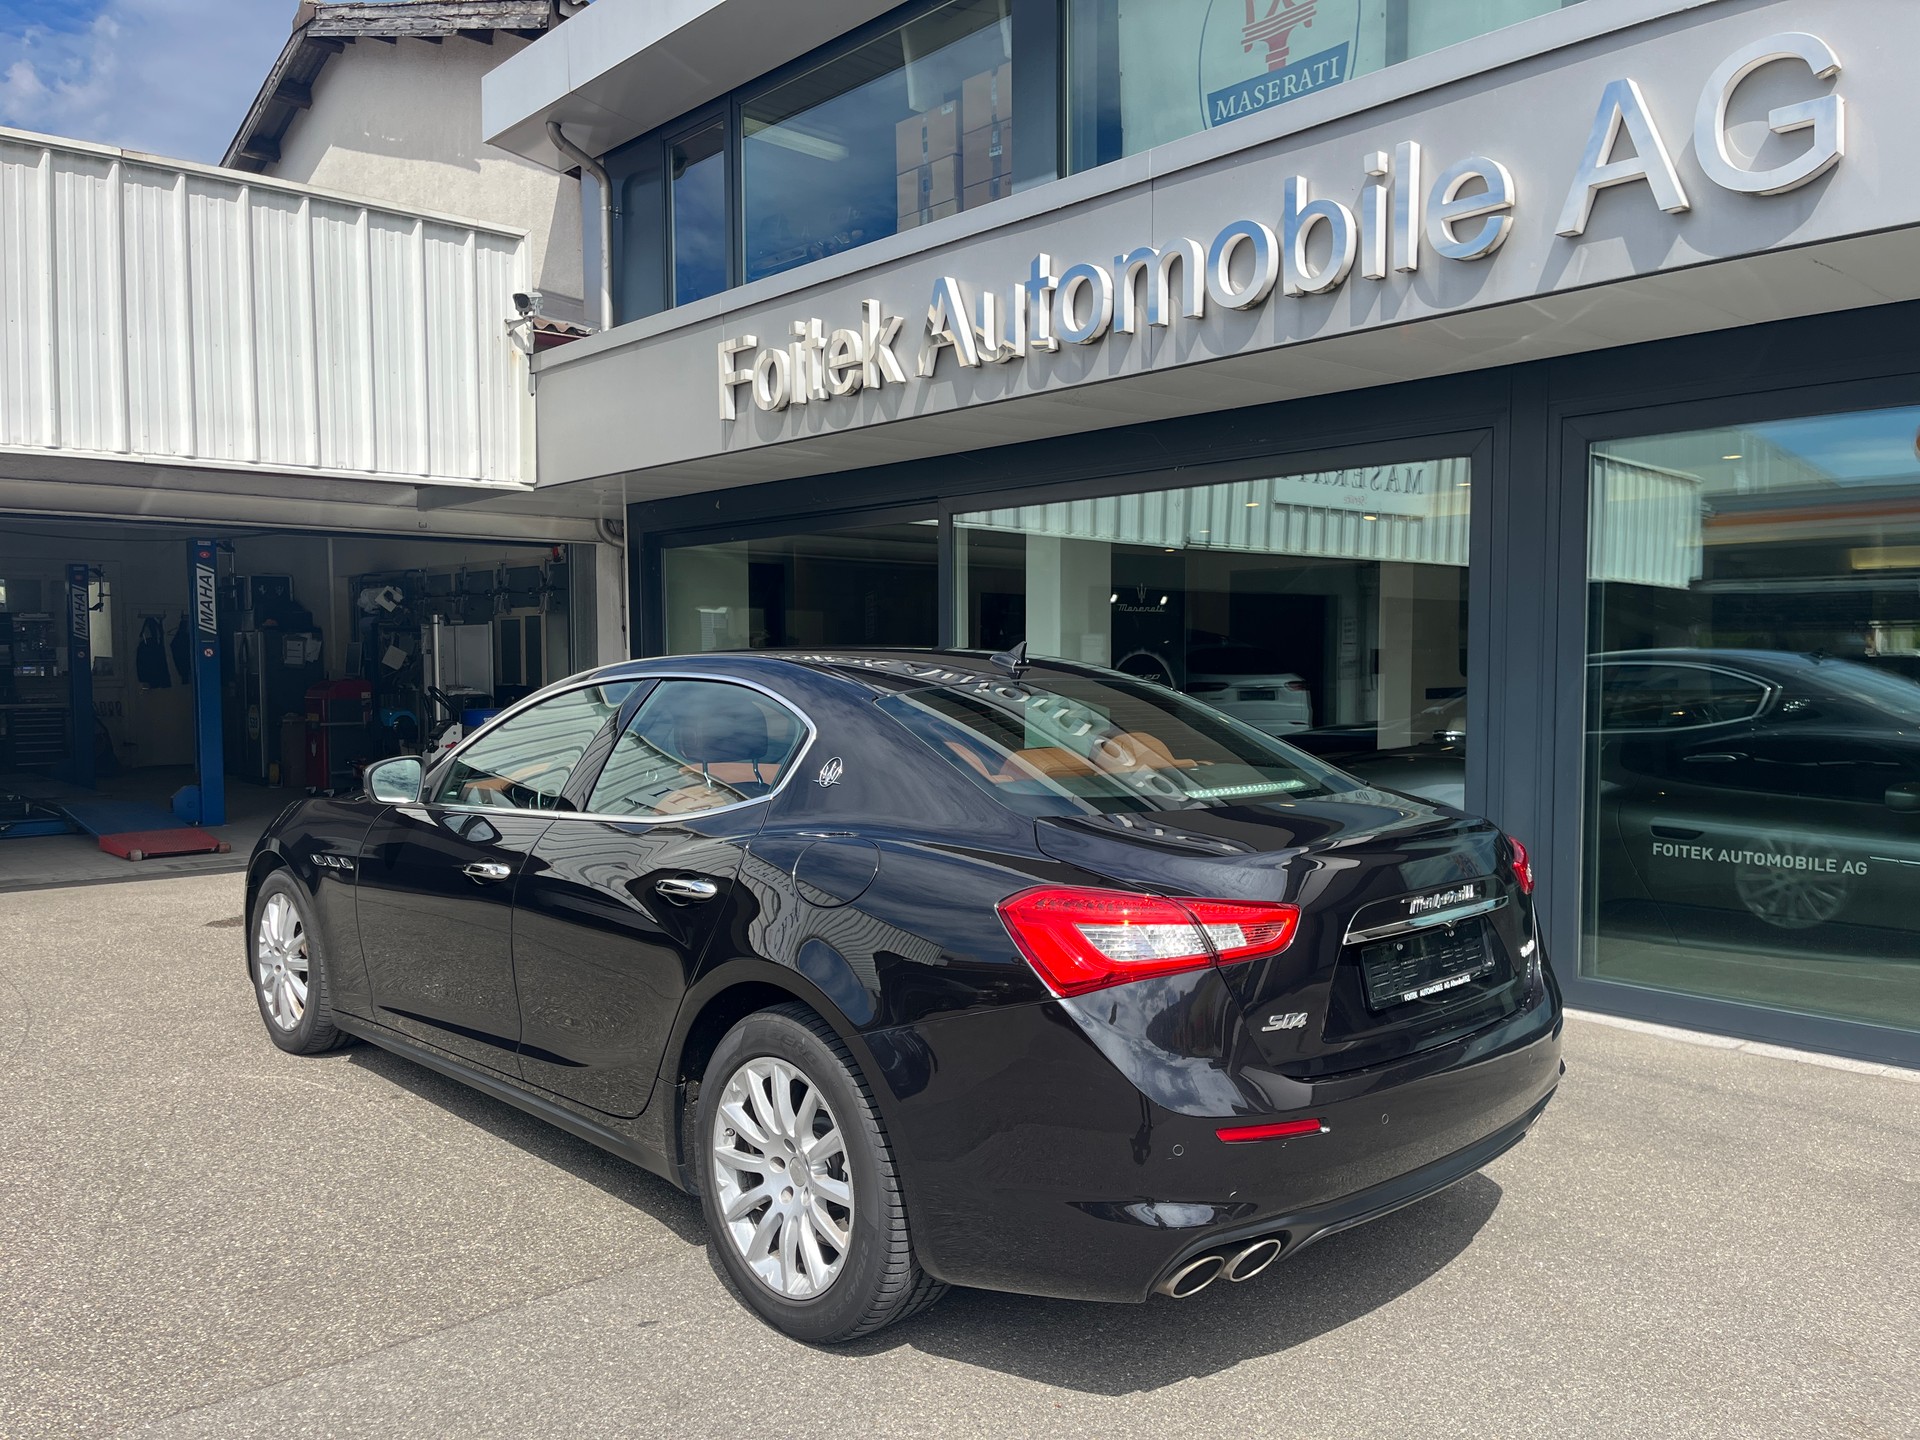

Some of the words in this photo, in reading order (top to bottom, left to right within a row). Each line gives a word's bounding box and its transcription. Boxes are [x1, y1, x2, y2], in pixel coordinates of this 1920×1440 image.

[1214, 56, 1340, 121] MASERATI
[718, 298, 907, 422] Foitek
[914, 140, 1516, 379] Automobile
[1555, 31, 1845, 239] AG
[73, 592, 88, 635] MAHA
[198, 573, 215, 629] MAHA
[1117, 603, 1166, 613] Maserati
[1652, 842, 1714, 861] FOITEK
[1718, 849, 1838, 873] AUTOMOBILE
[1841, 860, 1868, 876] AG
[1404, 991, 1419, 1002] FOITEK
[1419, 983, 1444, 997] AUTOMOBILE
[1444, 981, 1451, 989] AG
